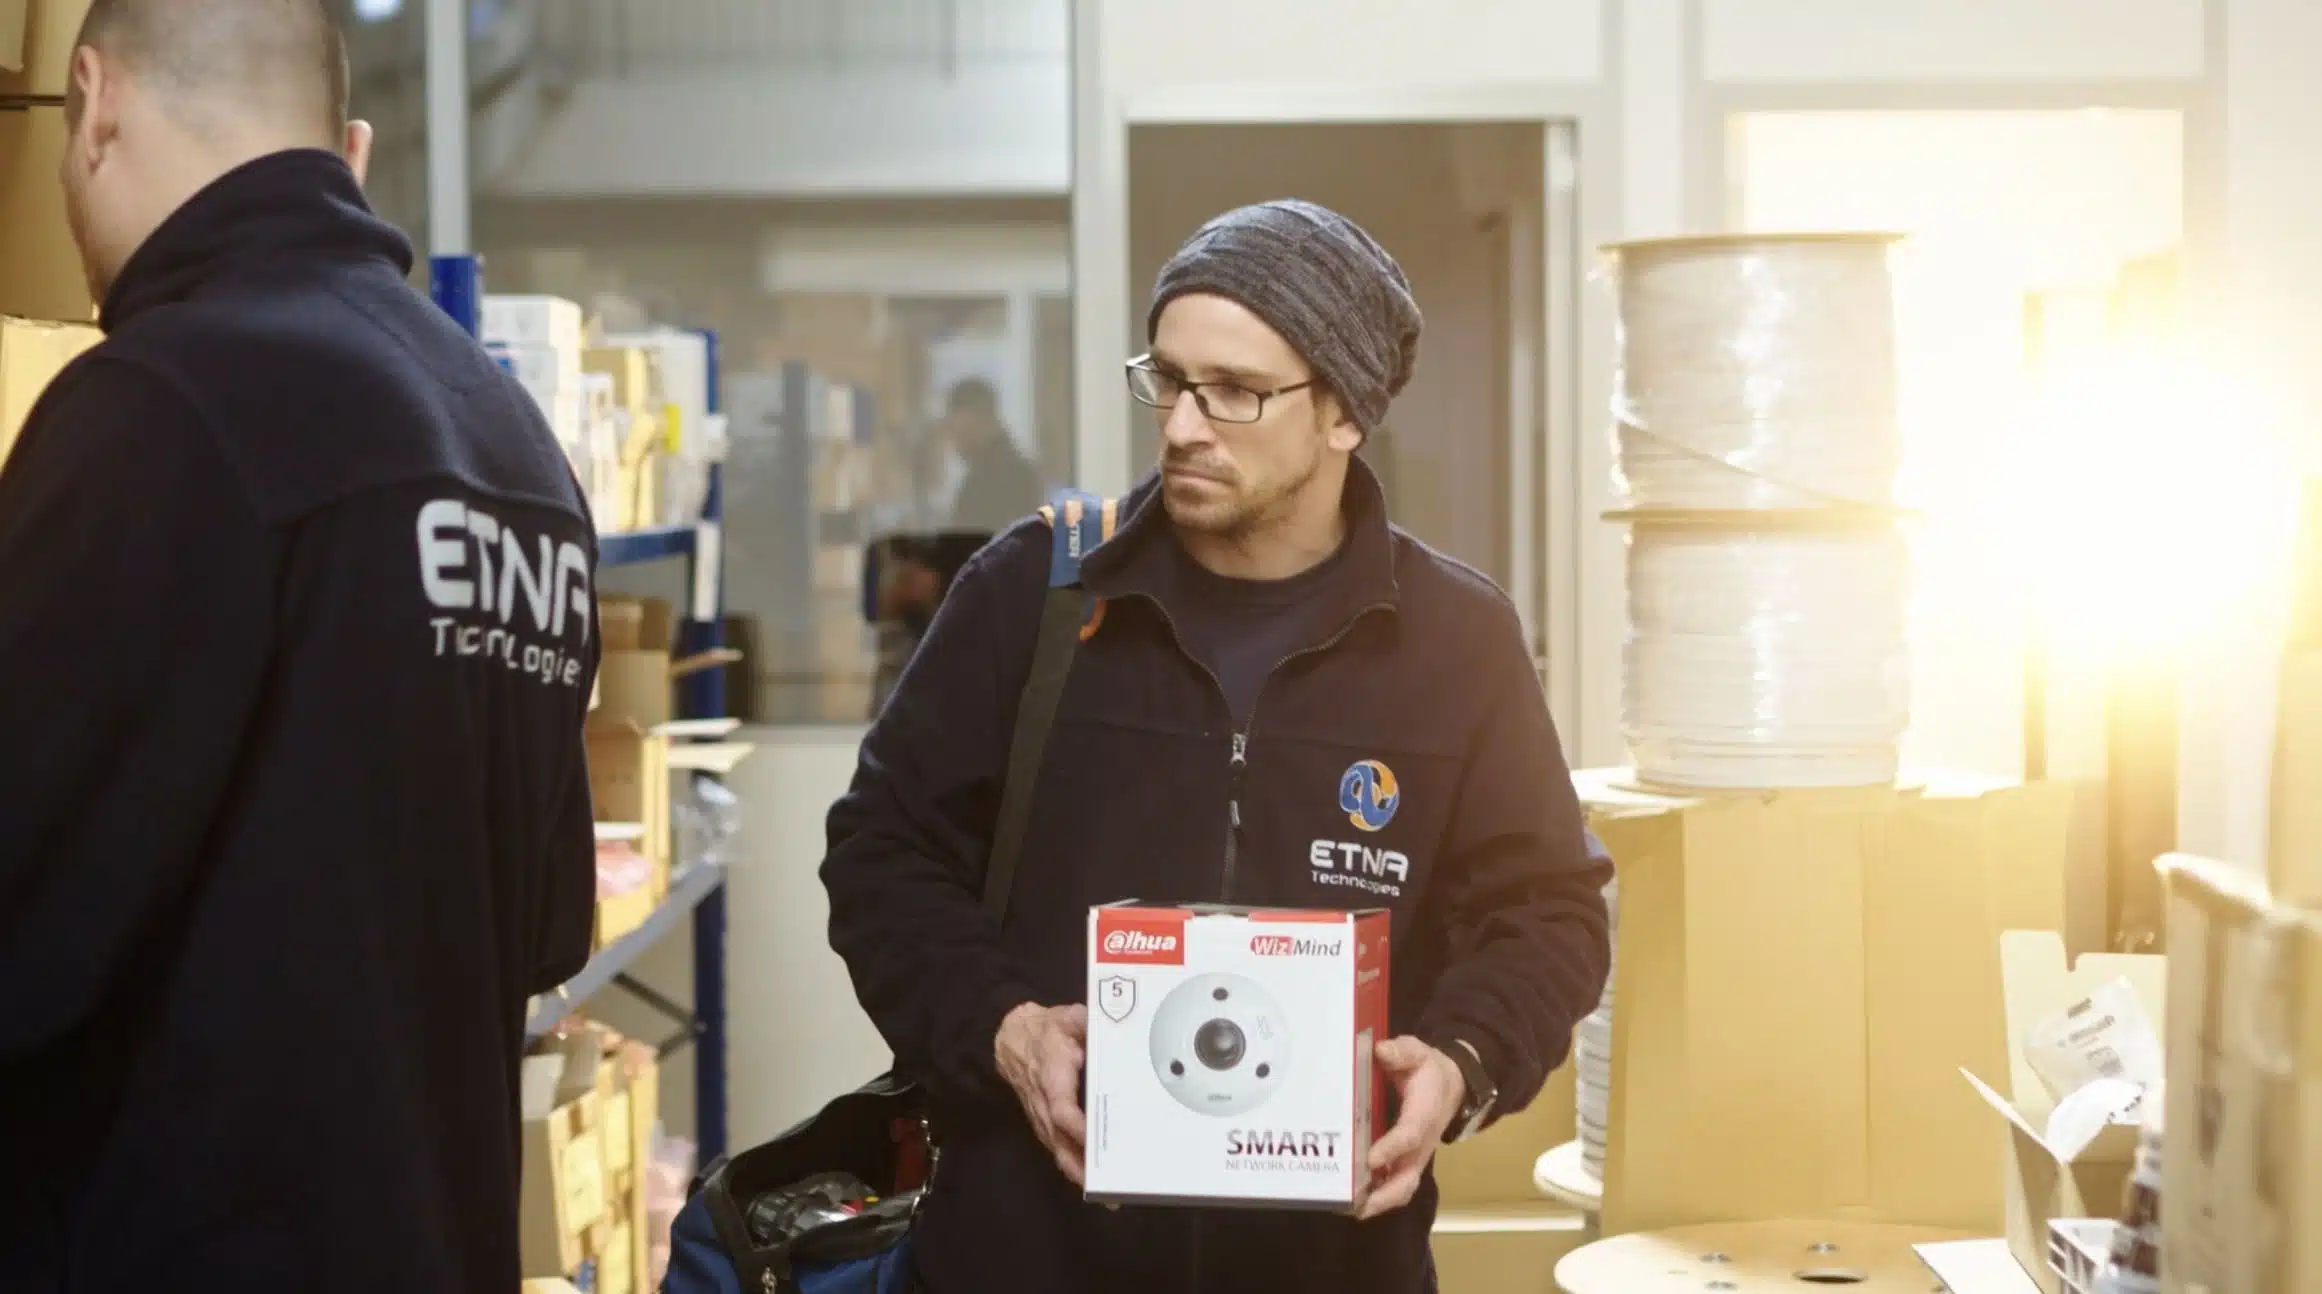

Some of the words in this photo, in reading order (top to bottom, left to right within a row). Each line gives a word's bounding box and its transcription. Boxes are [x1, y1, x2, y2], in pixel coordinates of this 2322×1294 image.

[416, 498, 591, 646] ETNA
[1310, 838, 1409, 883] ETNA
[1112, 981, 1123, 998] 5
[1226, 1128, 1341, 1158] SMART
[1225, 1158, 1286, 1172] NETWORK
[1288, 1159, 1340, 1174] CAMERA
